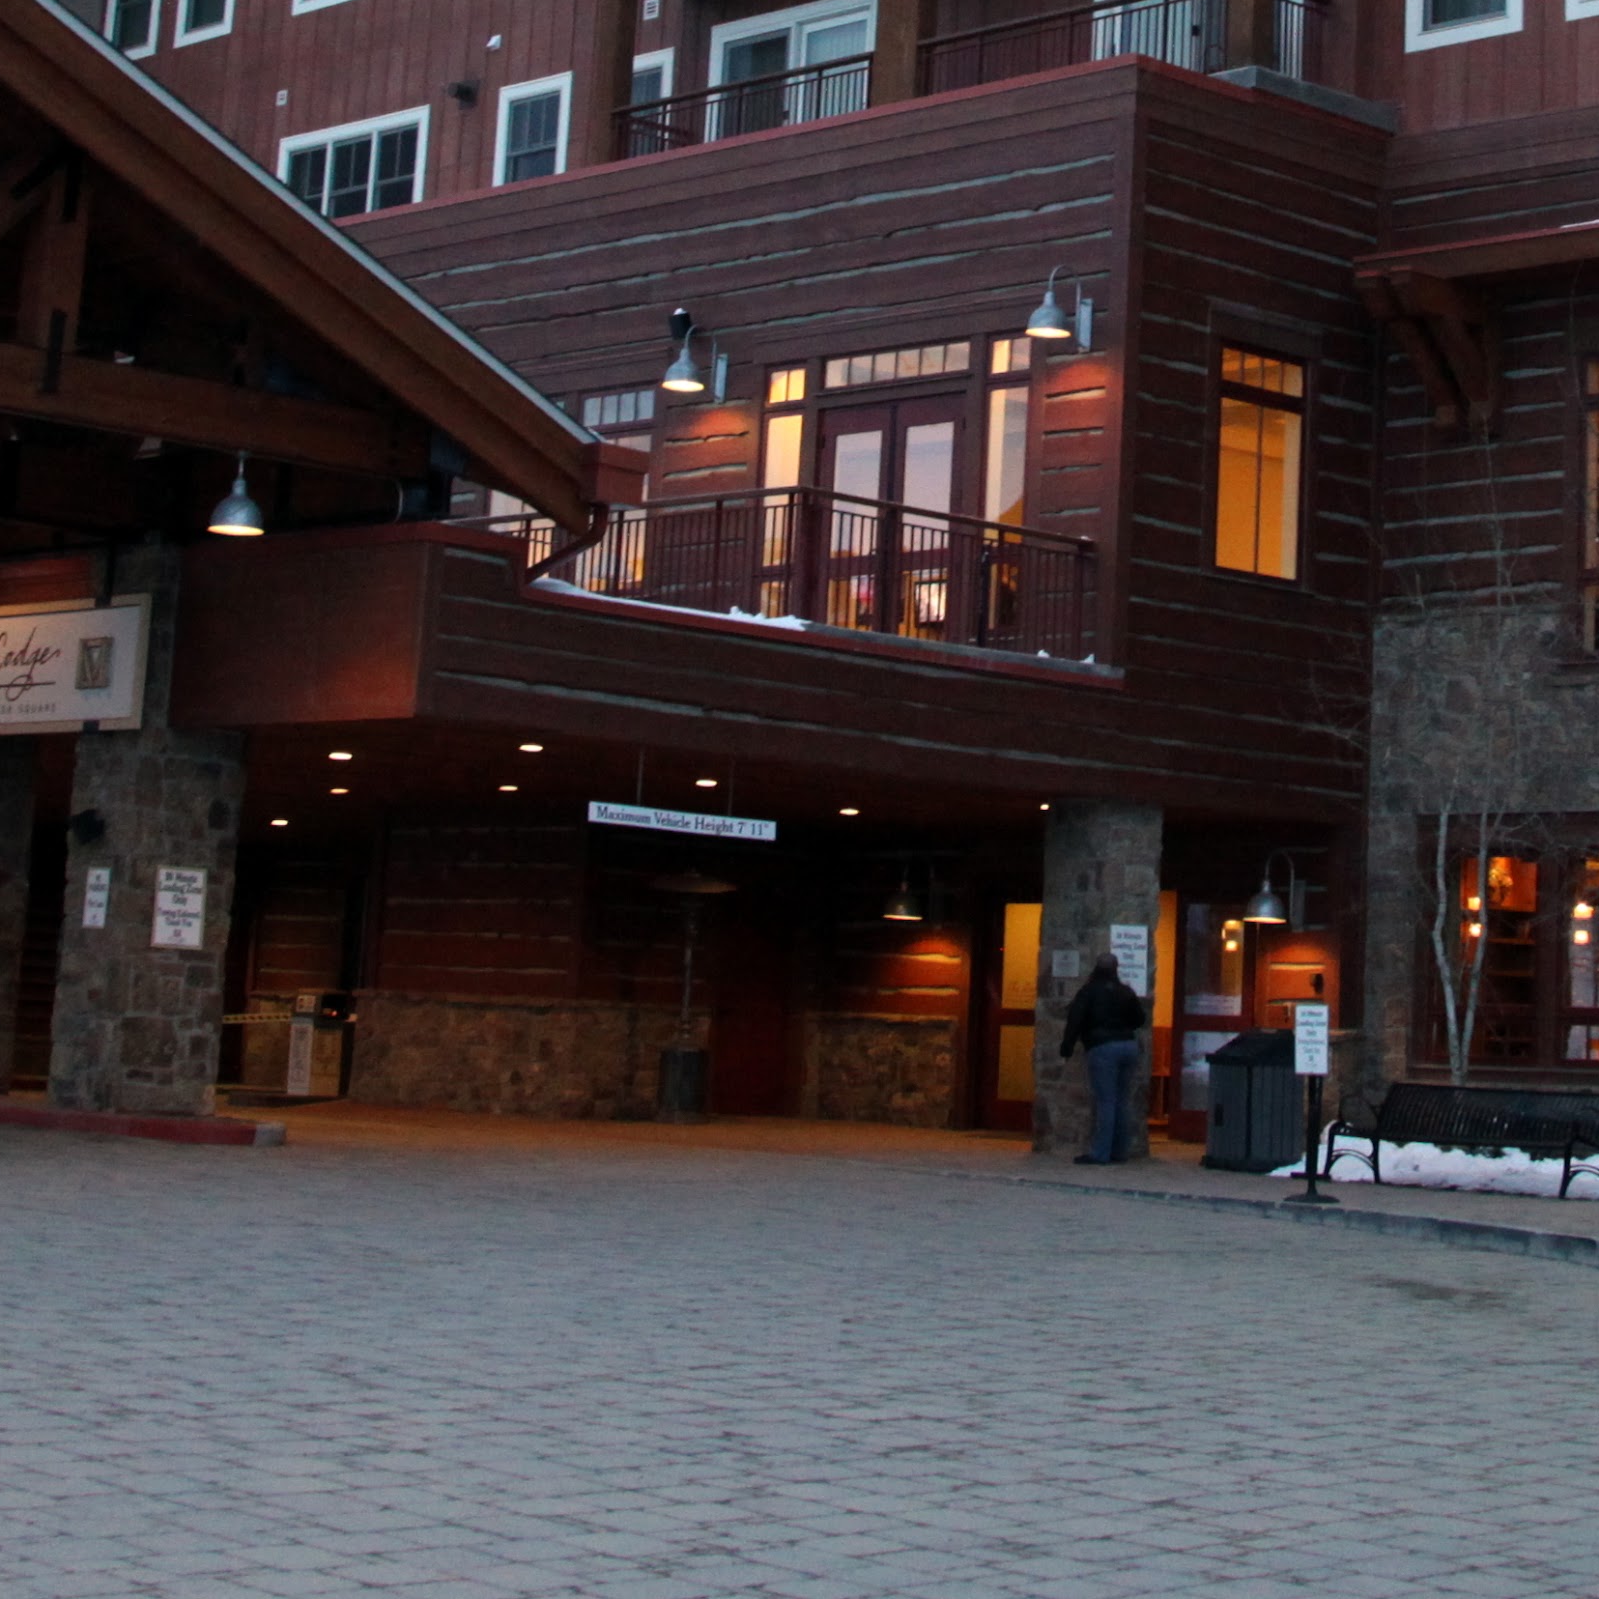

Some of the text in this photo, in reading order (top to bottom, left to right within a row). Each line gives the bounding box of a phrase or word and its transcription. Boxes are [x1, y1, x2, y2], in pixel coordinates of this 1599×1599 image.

[595, 805, 651, 825] Maximum
[654, 811, 691, 829] Vehicle
[694, 819, 734, 836] Height
